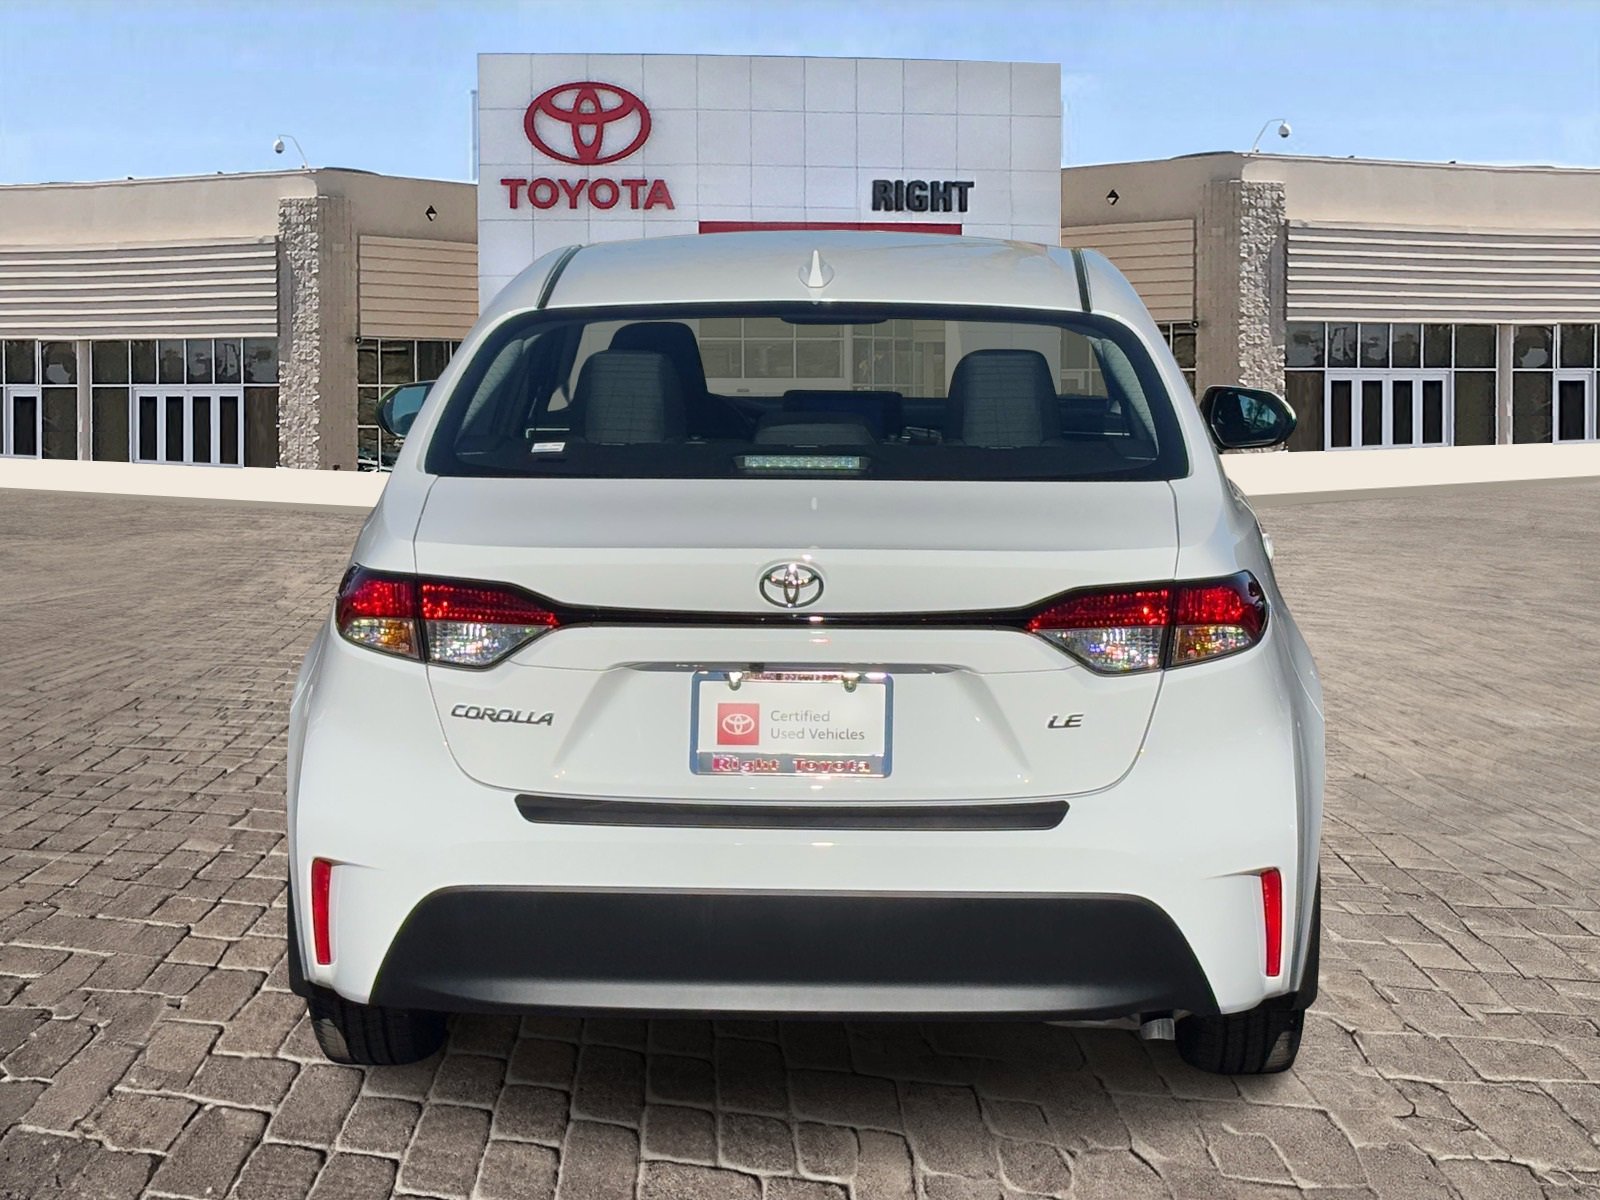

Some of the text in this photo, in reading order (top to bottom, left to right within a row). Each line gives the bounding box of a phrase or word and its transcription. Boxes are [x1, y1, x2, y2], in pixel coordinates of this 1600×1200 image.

[501, 178, 675, 210] TOYOTA
[871, 179, 975, 213] RIGHT
[451, 704, 555, 726] COROLLA
[770, 710, 830, 722] Certified
[1047, 714, 1084, 729] LE
[770, 728, 865, 740] Used Vehicles
[712, 755, 871, 774] Right Toyota
